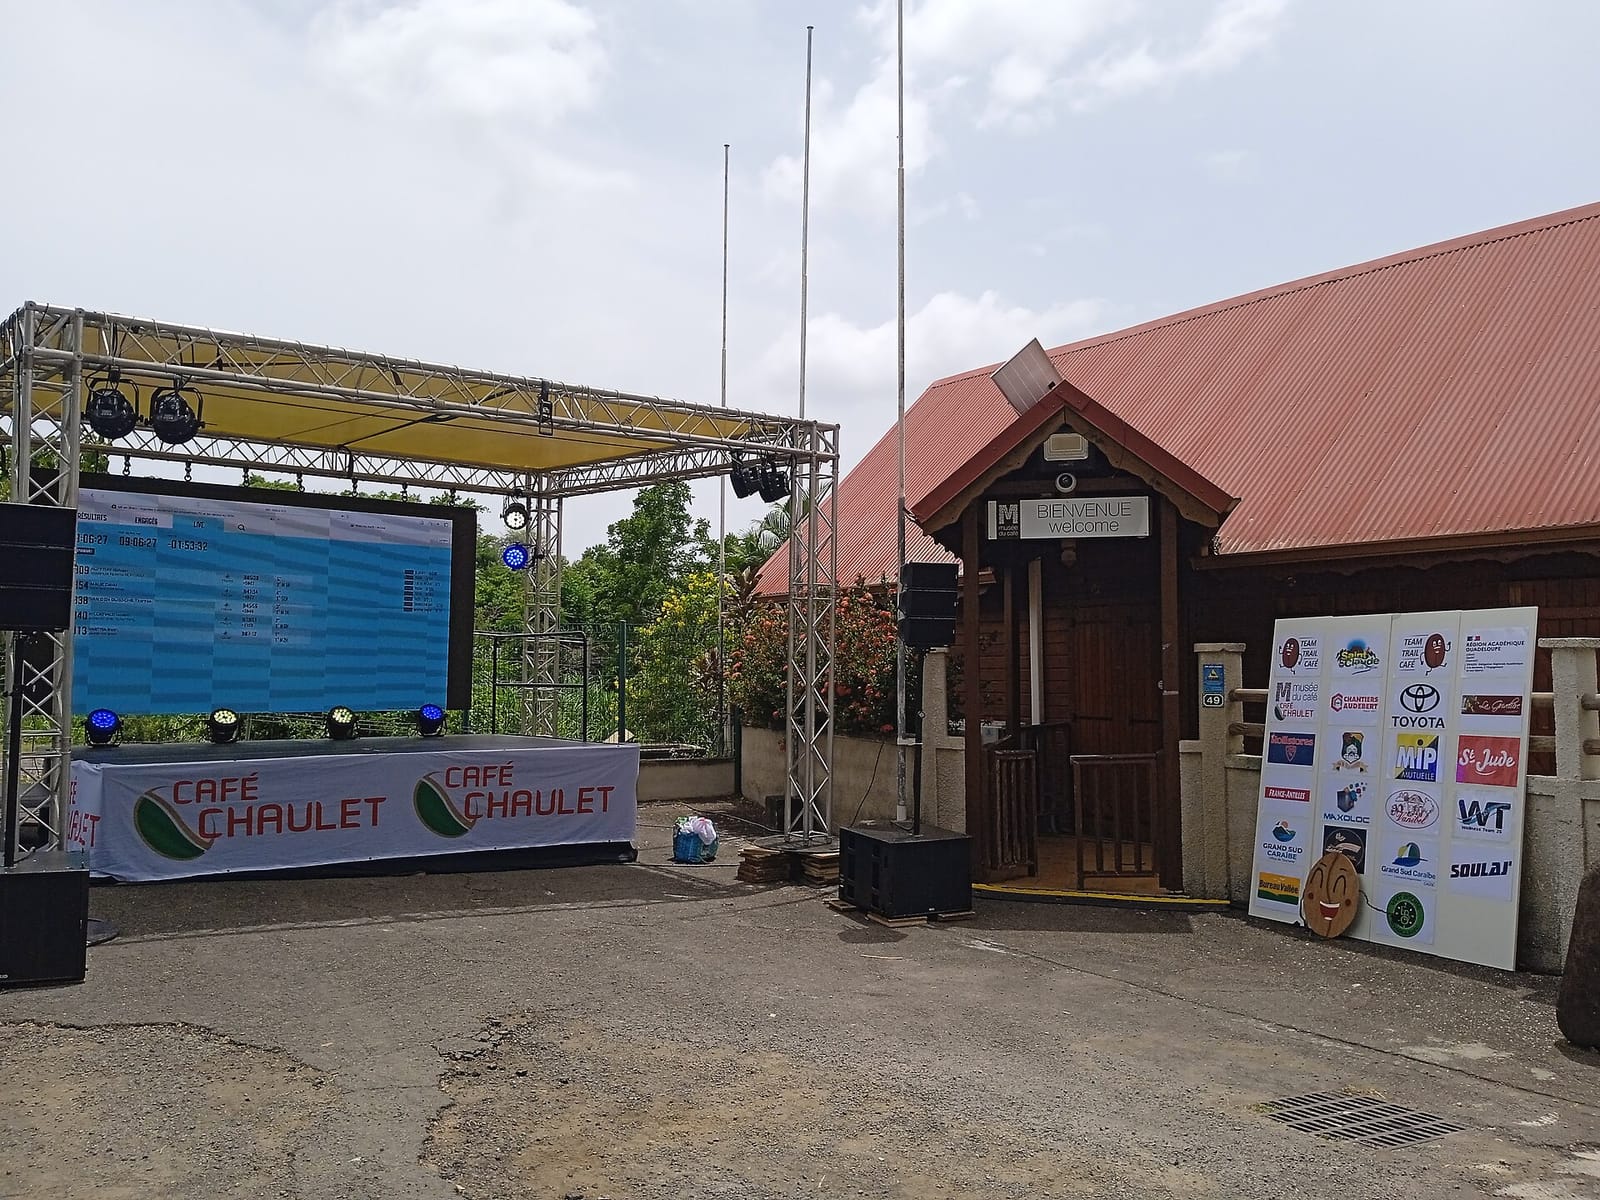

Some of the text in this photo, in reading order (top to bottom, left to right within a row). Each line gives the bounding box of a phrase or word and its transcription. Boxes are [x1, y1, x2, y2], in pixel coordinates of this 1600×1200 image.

[1037, 502, 1132, 518] BIENVENUE
[1048, 519, 1120, 533] welcome
[119, 536, 157, 548] 09:06:27
[167, 539, 208, 551] -01:53:32
[1304, 659, 1318, 667] CAFÉ
[1292, 682, 1318, 692] musée
[1303, 692, 1318, 701] café
[1392, 716, 1445, 728] TOYOTA
[1459, 748, 1515, 772] St Jude
[444, 760, 514, 789] CAFÉ
[1402, 770, 1435, 781] MUTUELLE
[173, 772, 258, 805] CAFÉ
[464, 785, 614, 819] CHAULET
[198, 796, 386, 839] CHAULET
[1263, 843, 1287, 852] GRAND
[1267, 850, 1297, 860] CARAÏBE
[1413, 870, 1436, 880] Caraïbe
